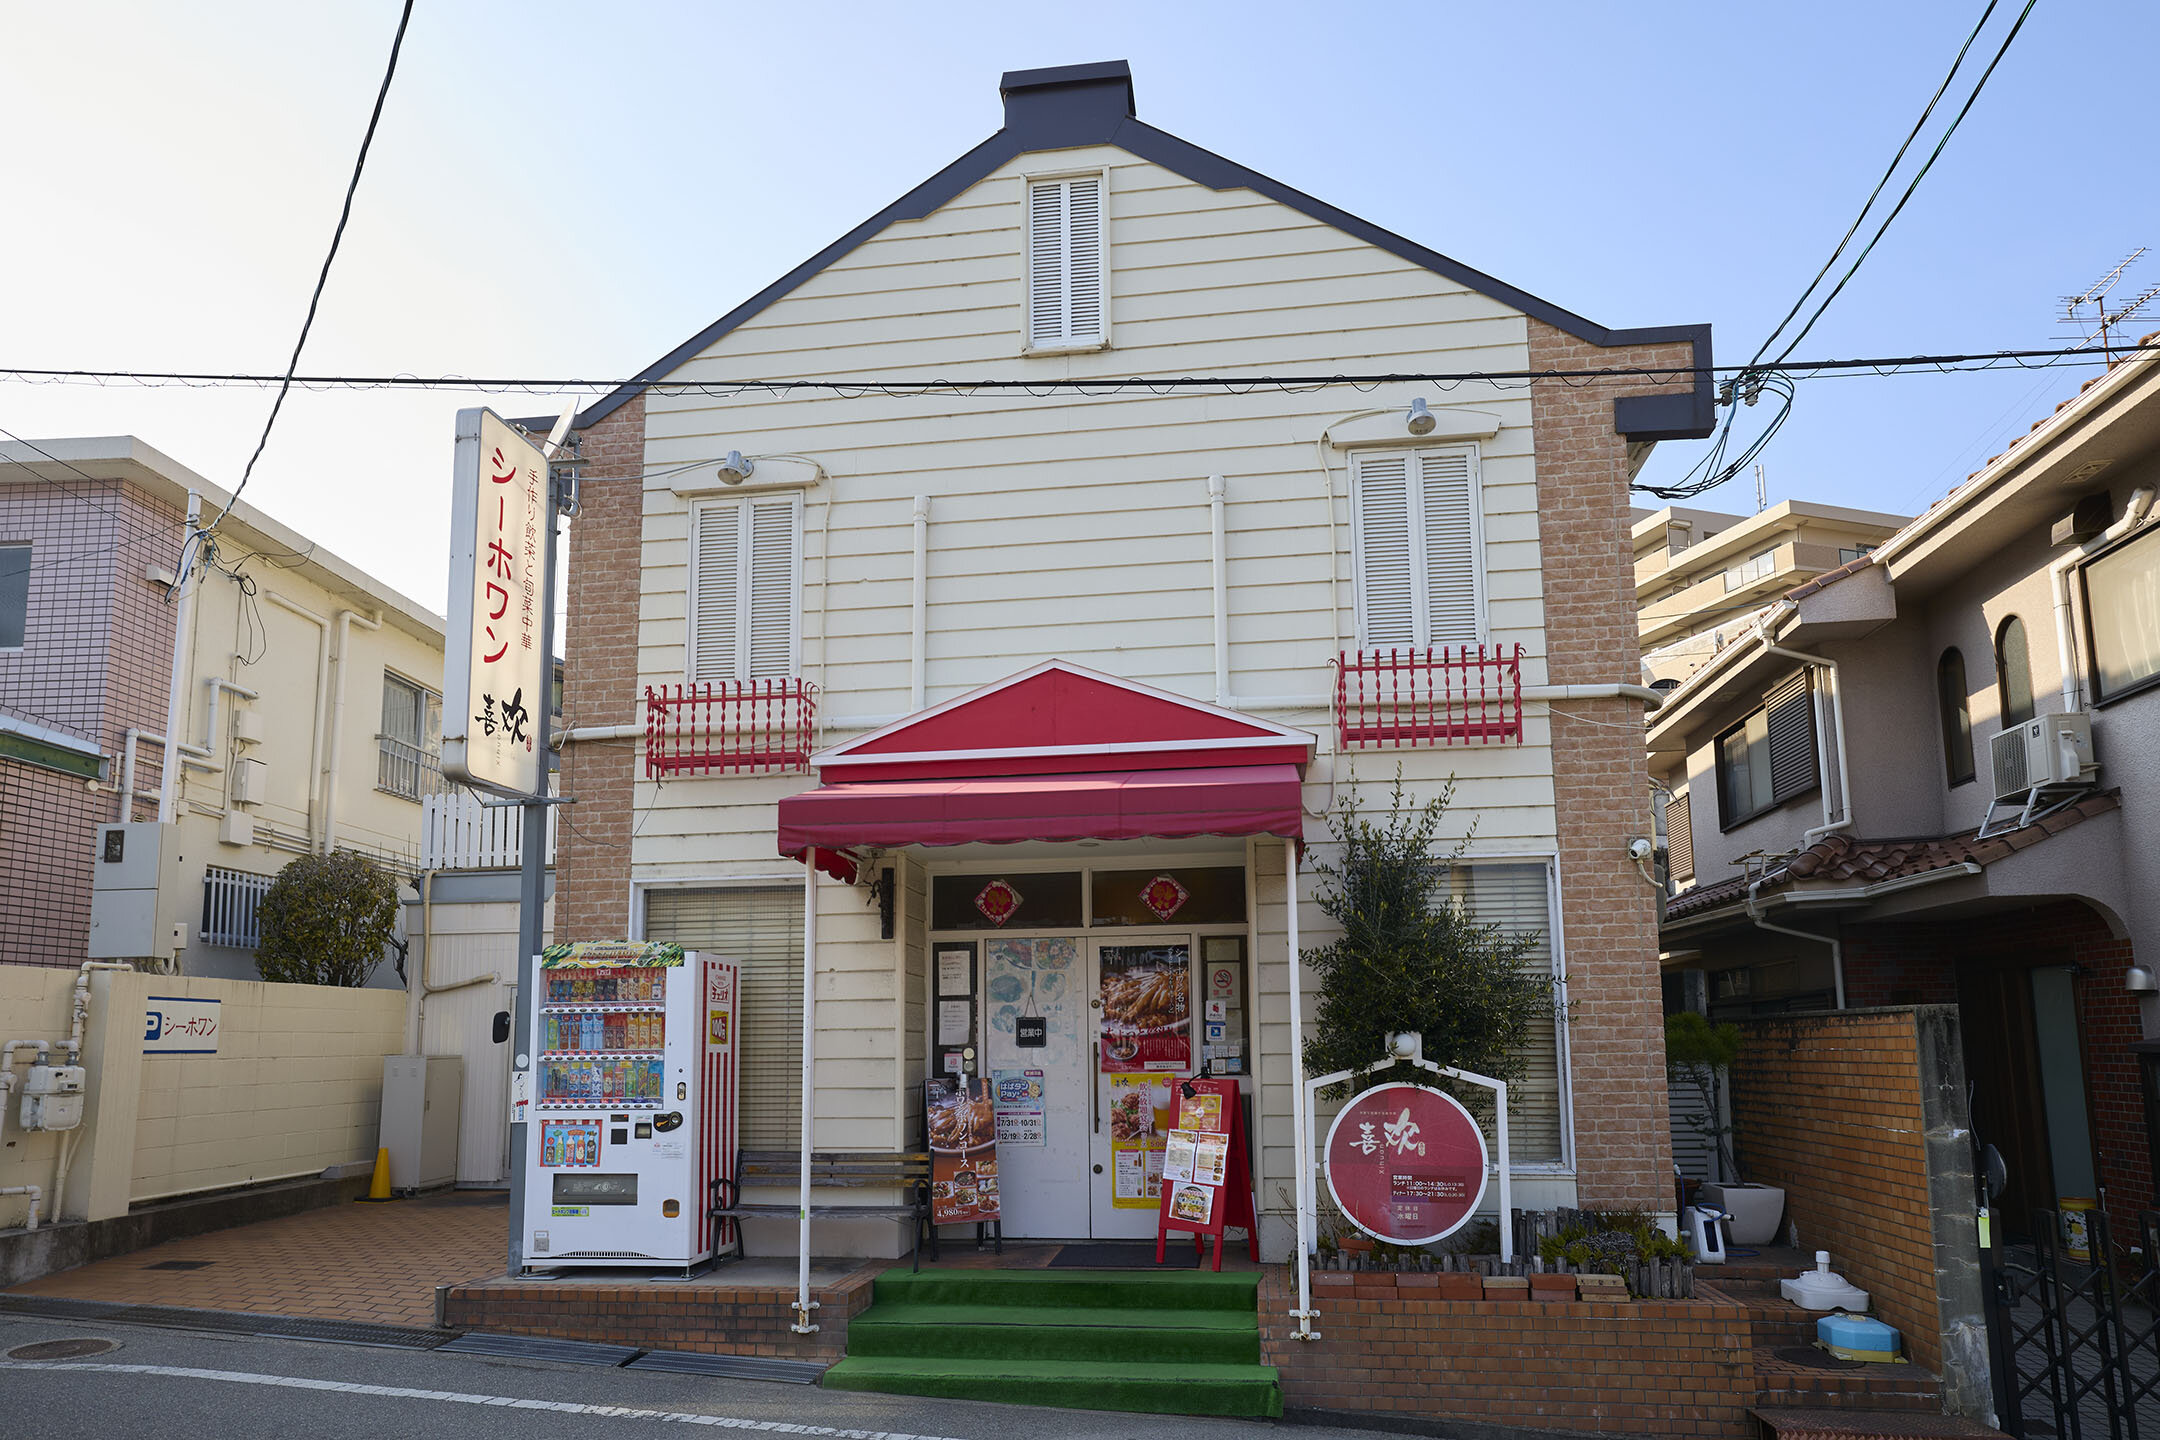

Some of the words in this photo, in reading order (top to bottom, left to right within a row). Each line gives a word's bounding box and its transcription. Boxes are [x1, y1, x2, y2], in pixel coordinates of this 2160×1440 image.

[483, 446, 517, 664] シーホワン
[164, 1016, 217, 1037] シーホワン
[1020, 1028, 1043, 1038] 営業中
[1397, 1212, 1419, 1220] 水曜日
